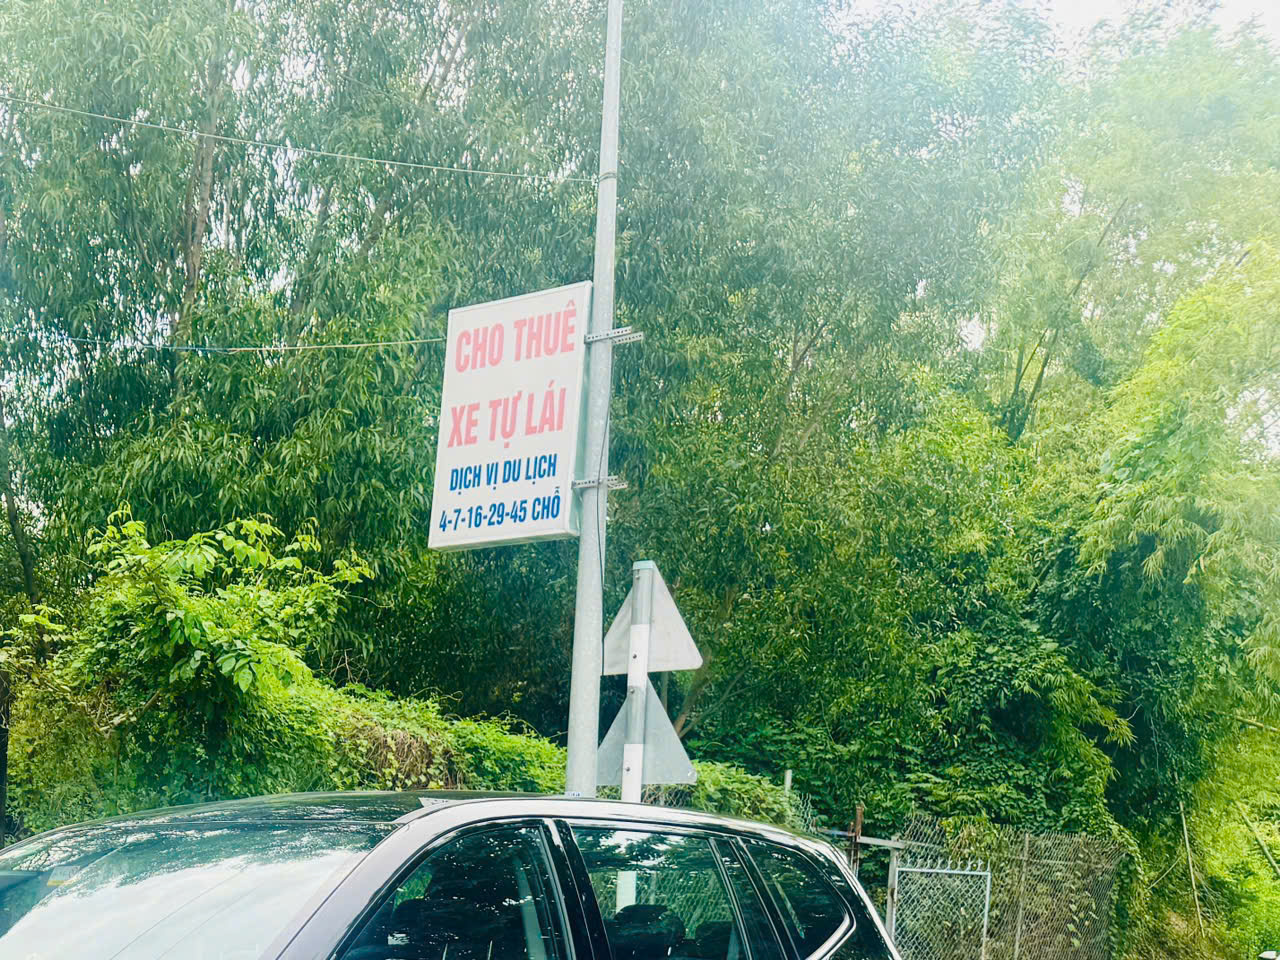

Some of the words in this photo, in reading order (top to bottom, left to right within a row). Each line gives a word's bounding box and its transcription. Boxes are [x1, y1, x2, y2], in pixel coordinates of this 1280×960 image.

[455, 323, 505, 373] CHO
[513, 299, 577, 362] THUÊ
[447, 402, 480, 448] XE
[488, 390, 523, 449] TỰ
[525, 380, 567, 436] LÁI
[449, 464, 482, 495] DỊCH
[486, 461, 499, 490] VỊ
[502, 458, 521, 484] DU
[525, 453, 557, 485] LỊCH
[439, 499, 527, 532] 4-7-16-29-45
[532, 486, 561, 521] CHỖ
